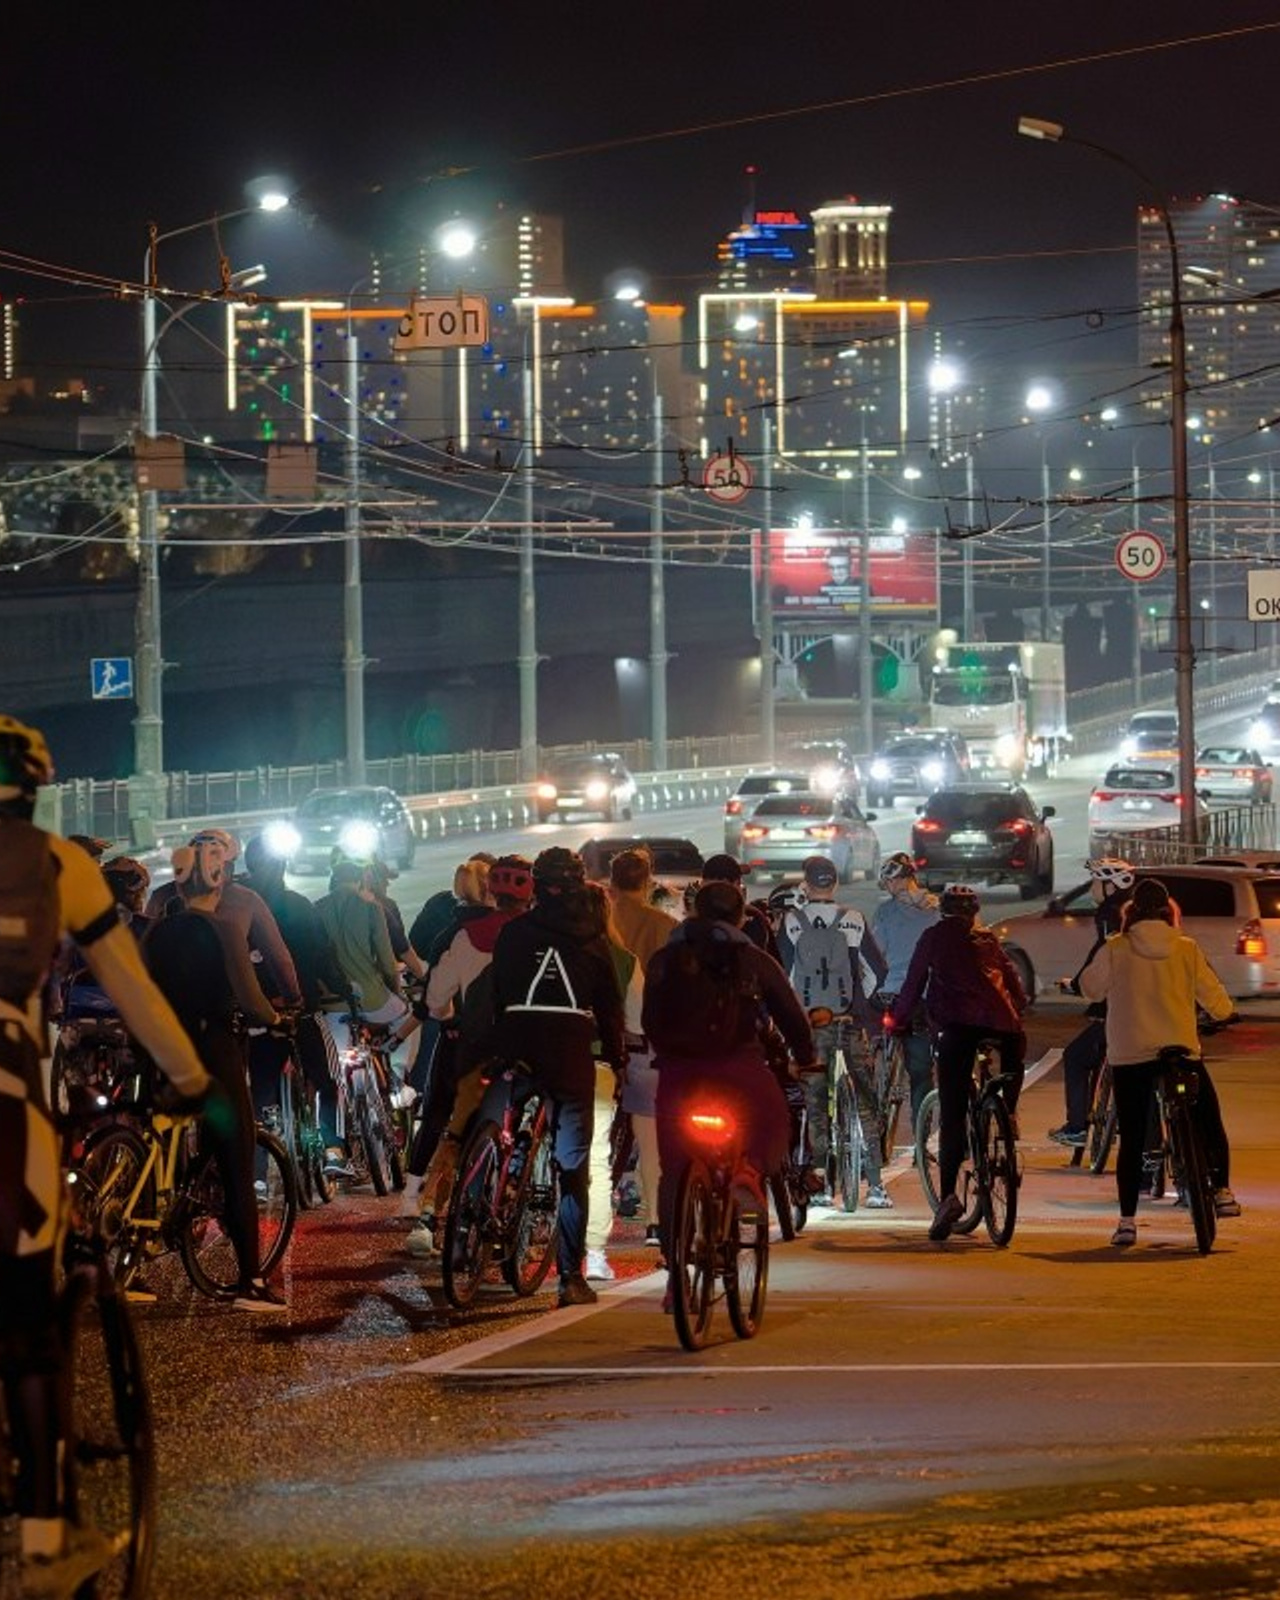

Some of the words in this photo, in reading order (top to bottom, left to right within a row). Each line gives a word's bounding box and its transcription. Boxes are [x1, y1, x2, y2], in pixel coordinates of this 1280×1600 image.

[398, 310, 479, 337] СТОП
[714, 469, 741, 487] 50
[1126, 547, 1155, 567] 50
